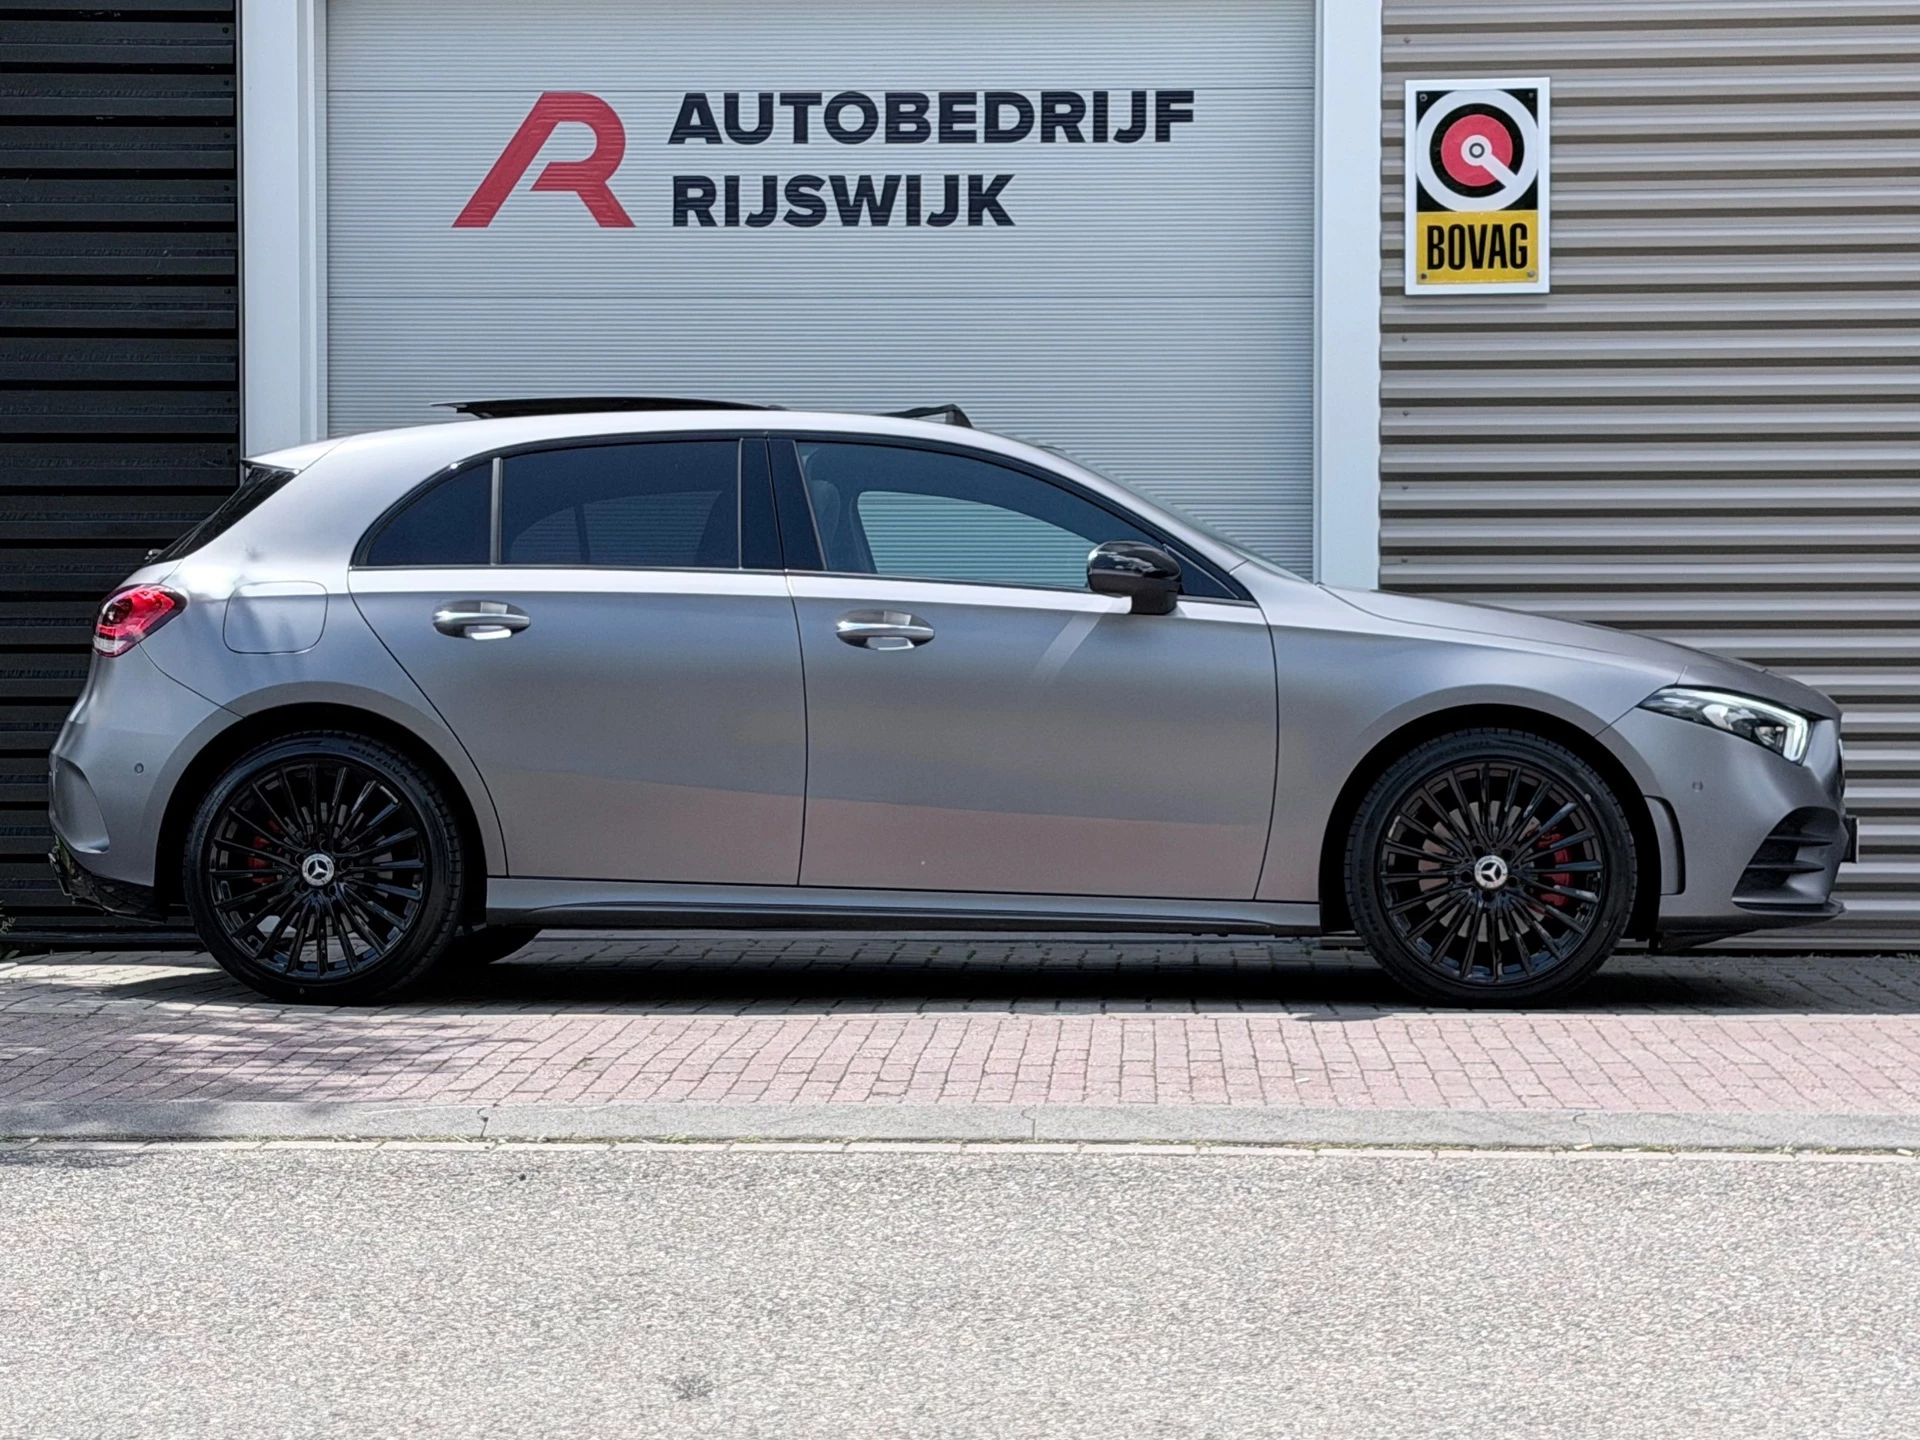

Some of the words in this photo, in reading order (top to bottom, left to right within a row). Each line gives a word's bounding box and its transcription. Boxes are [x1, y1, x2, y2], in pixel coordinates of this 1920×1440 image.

[667, 89, 1195, 145] AUTOBEDRIJF
[672, 174, 1016, 228] RIJSWIJK
[1426, 222, 1529, 271] BOVAG
